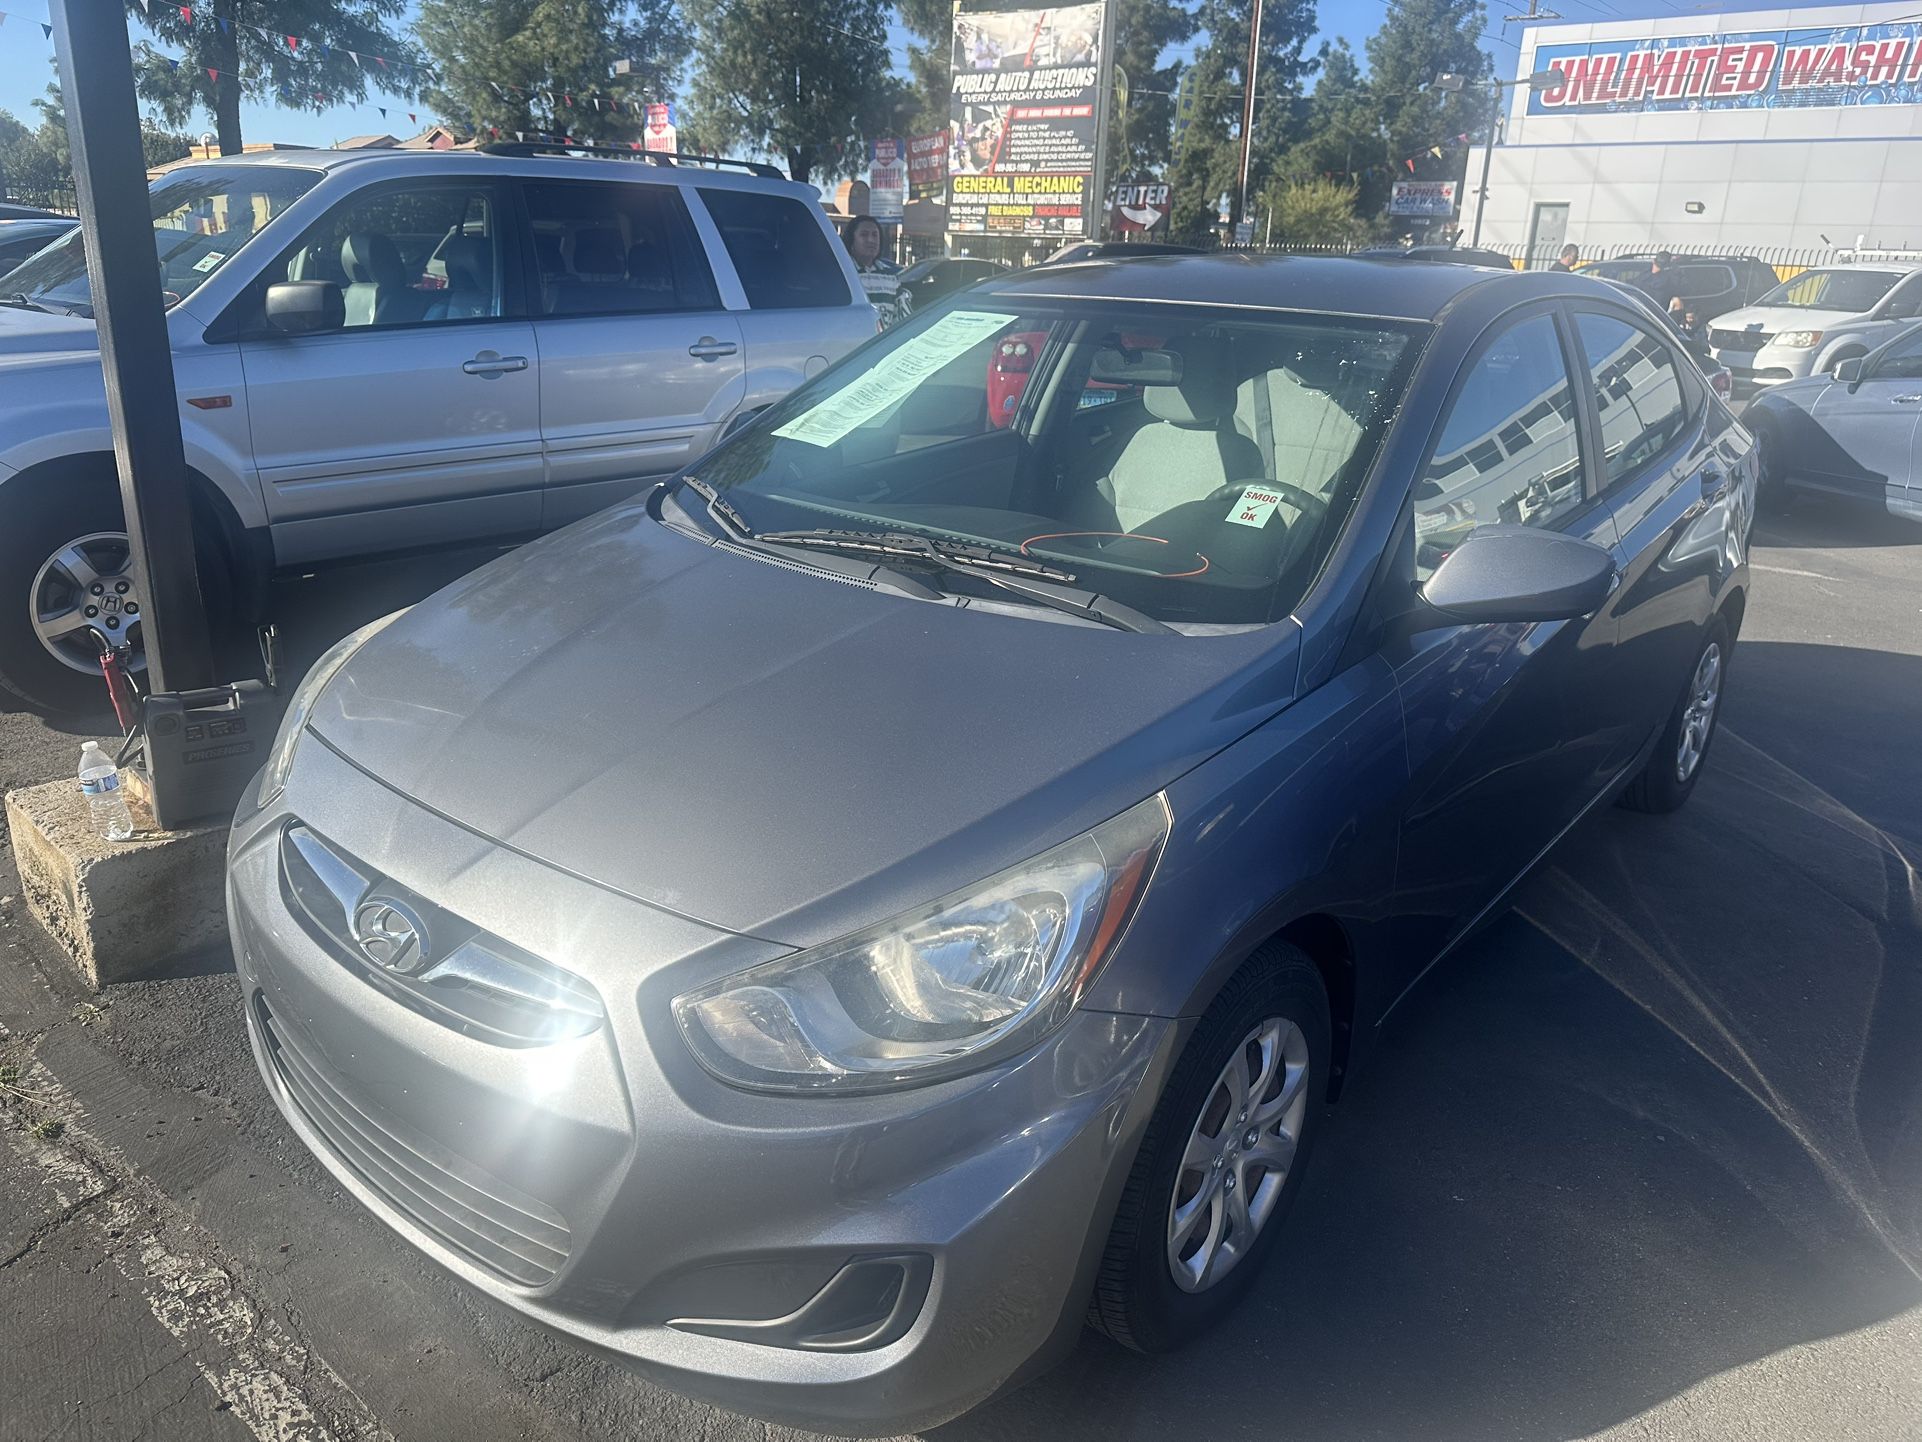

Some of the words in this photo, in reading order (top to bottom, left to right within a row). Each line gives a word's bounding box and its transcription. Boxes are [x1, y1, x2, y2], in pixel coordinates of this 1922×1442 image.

[952, 74, 996, 94] PUBLIC
[996, 73, 1029, 91] AUTO
[1030, 67, 1096, 88] AUCTIONS
[1541, 41, 1777, 106] UNLIMITED
[1779, 41, 1906, 90] WASH
[961, 92, 990, 103] EVERY
[990, 91, 1035, 102] SATURDAY
[1043, 88, 1082, 99] SUNDAY
[953, 176, 1011, 193] GENERAL
[1013, 176, 1084, 193] MECHANIC
[1116, 185, 1169, 206] ENTER
[1244, 491, 1278, 504] SMOG
[1240, 511, 1257, 522] OK
